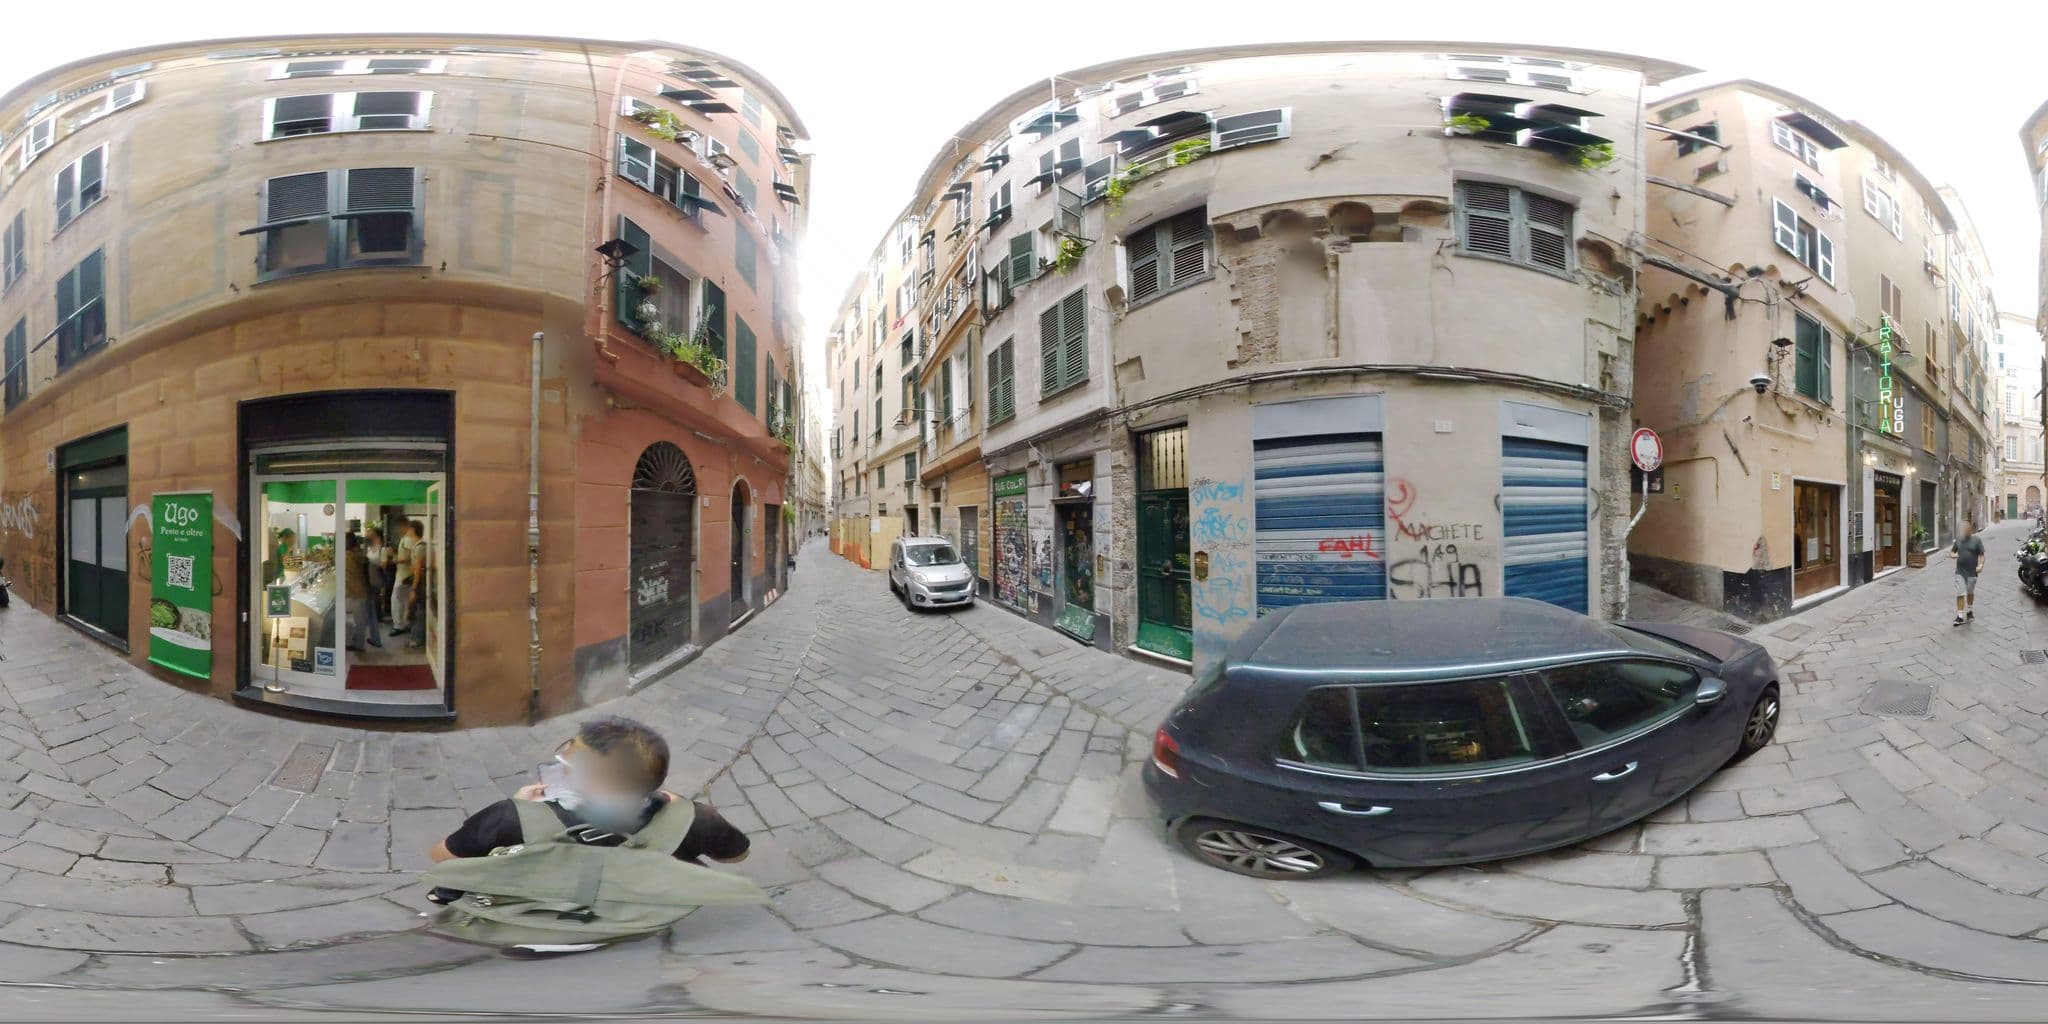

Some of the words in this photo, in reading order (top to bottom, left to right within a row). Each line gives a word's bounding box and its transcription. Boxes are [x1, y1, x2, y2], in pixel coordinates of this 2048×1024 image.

[1879, 315, 1893, 434] TRATTORIA
[1893, 397, 1904, 433] UGO
[165, 503, 198, 526] Ugo
[1395, 522, 1484, 541] MACHETE
